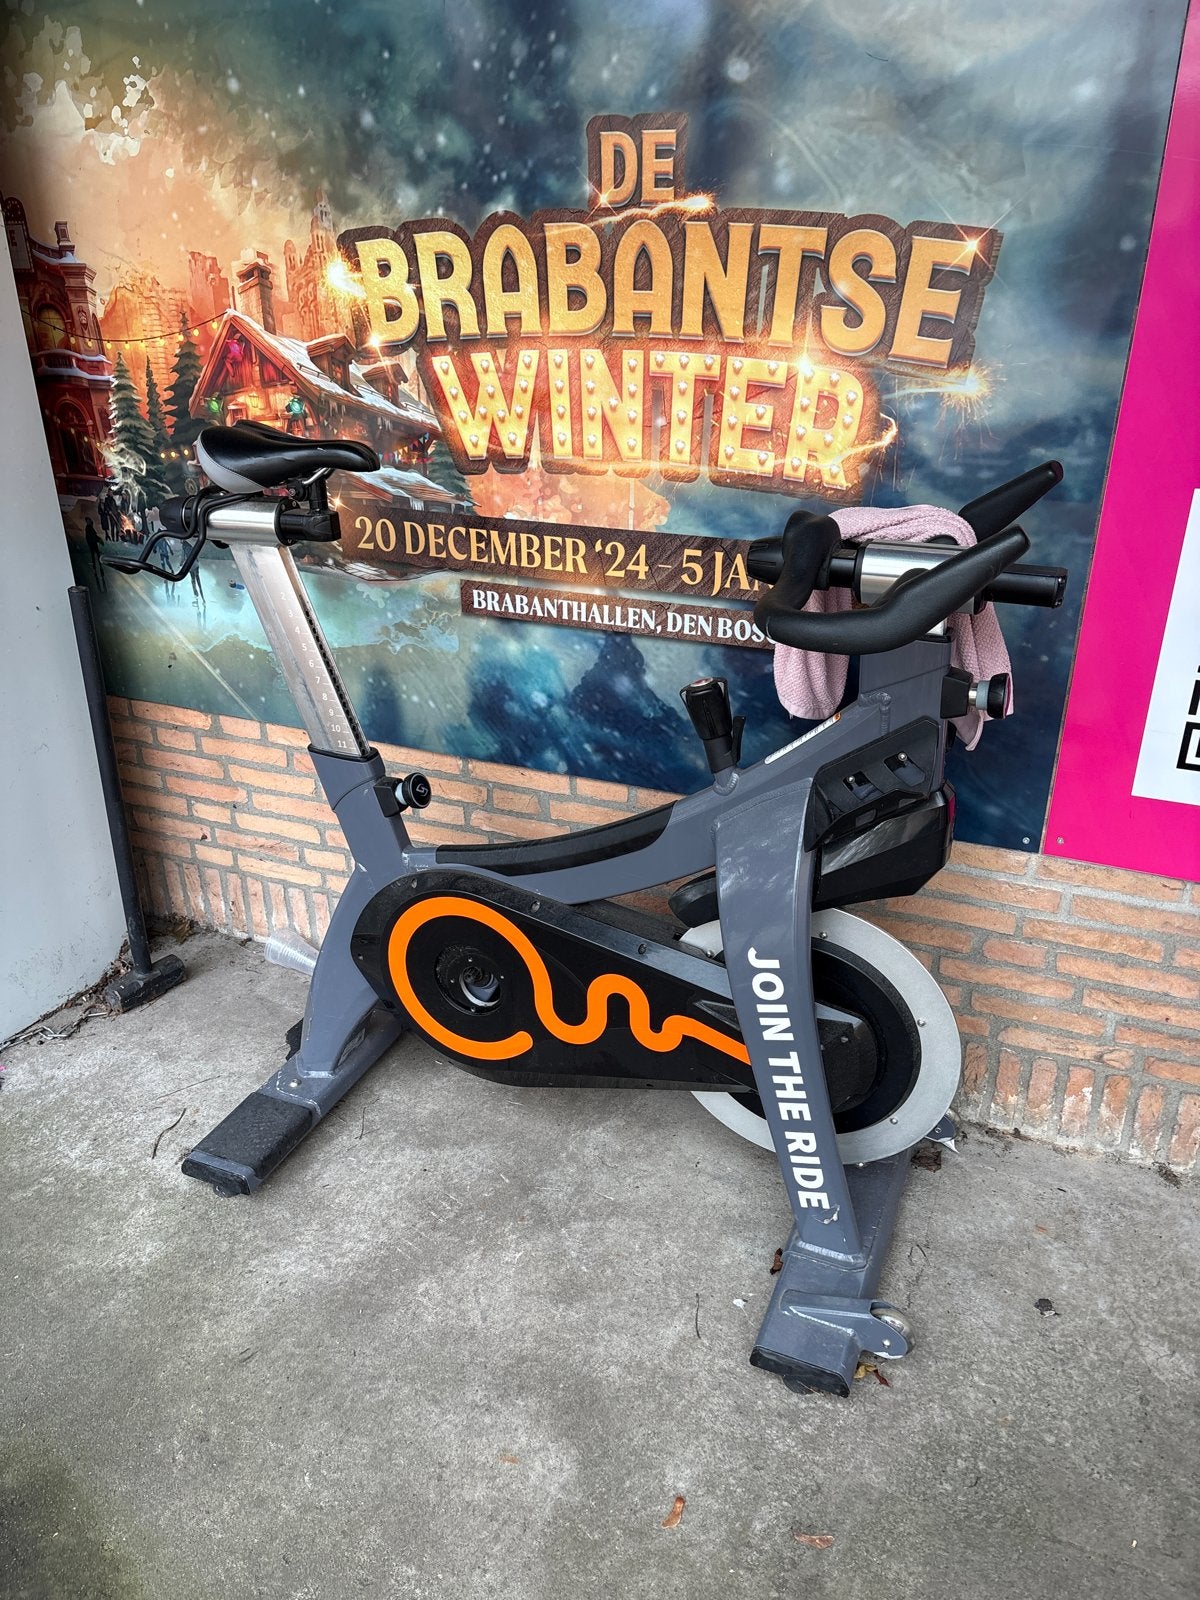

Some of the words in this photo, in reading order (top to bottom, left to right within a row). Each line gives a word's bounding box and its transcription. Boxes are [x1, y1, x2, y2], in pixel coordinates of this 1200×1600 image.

[599, 128, 677, 207] DE
[354, 220, 973, 368] BRABANTSE
[430, 347, 864, 489] WINTER
[354, 516, 396, 552] 20
[402, 521, 589, 574] DECEMBER
[680, 548, 703, 586] 5
[711, 550, 774, 597] JA
[472, 588, 662, 634] BRABANTHALLEN,
[666, 611, 713, 638] DEN
[717, 617, 777, 645] BOS
[309, 660, 315, 668] 6
[316, 676, 321, 684] 7
[322, 692, 328, 701] 8
[331, 724, 341, 732] 10
[337, 740, 347, 748] 11
[747, 946, 794, 1041] JOIN
[768, 1051, 811, 1121] THE
[785, 1131, 830, 1210] RIDE
